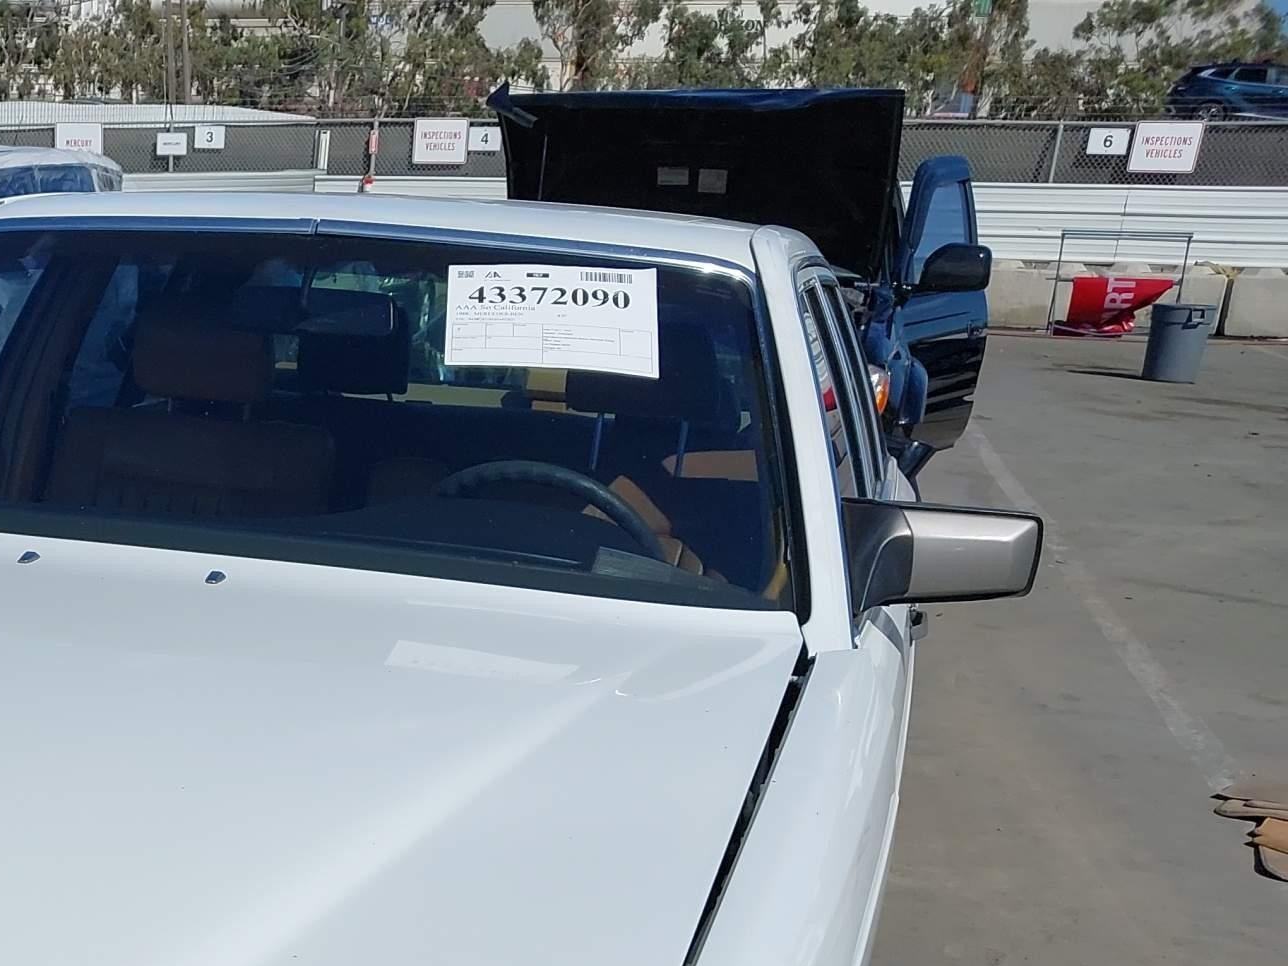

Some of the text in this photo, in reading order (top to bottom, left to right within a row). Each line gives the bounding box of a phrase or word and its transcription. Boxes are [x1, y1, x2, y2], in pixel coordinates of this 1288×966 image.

[205, 131, 214, 143] 3
[420, 130, 462, 140] INSPECTIONS
[480, 133, 489, 144] 4
[1103, 135, 1113, 148] 6
[1141, 136, 1193, 146] INSPECTIONS
[425, 142, 456, 151] VEHICLES
[1145, 149, 1183, 159] VEHICLES
[468, 286, 631, 309] 43372090
